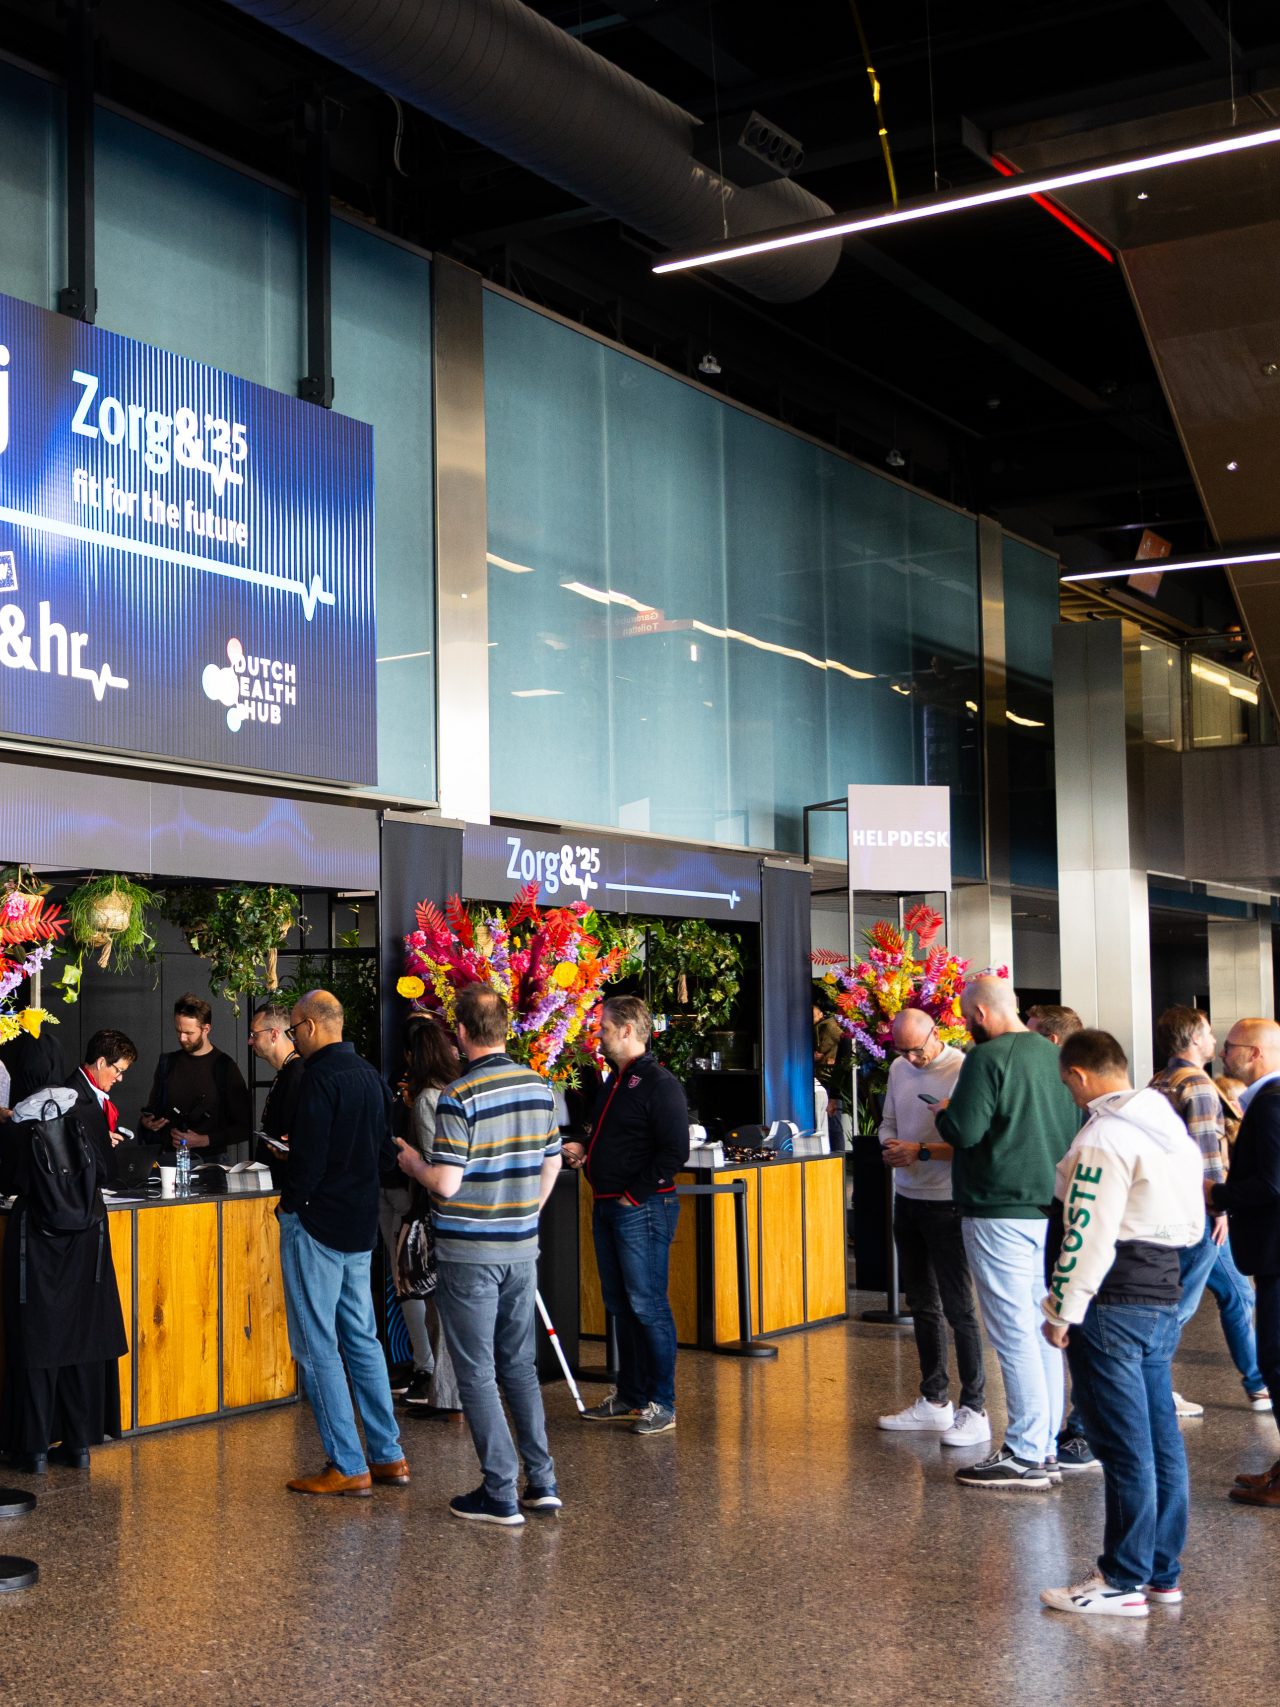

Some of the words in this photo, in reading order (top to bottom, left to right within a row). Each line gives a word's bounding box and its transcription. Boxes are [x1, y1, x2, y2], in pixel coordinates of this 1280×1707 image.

[73, 467, 99, 508] fit
[105, 476, 137, 518] for
[143, 490, 179, 529] the
[185, 499, 249, 548] future
[234, 654, 296, 684] DUTCH
[243, 699, 281, 725] HUB
[852, 829, 951, 848] HELPDESK
